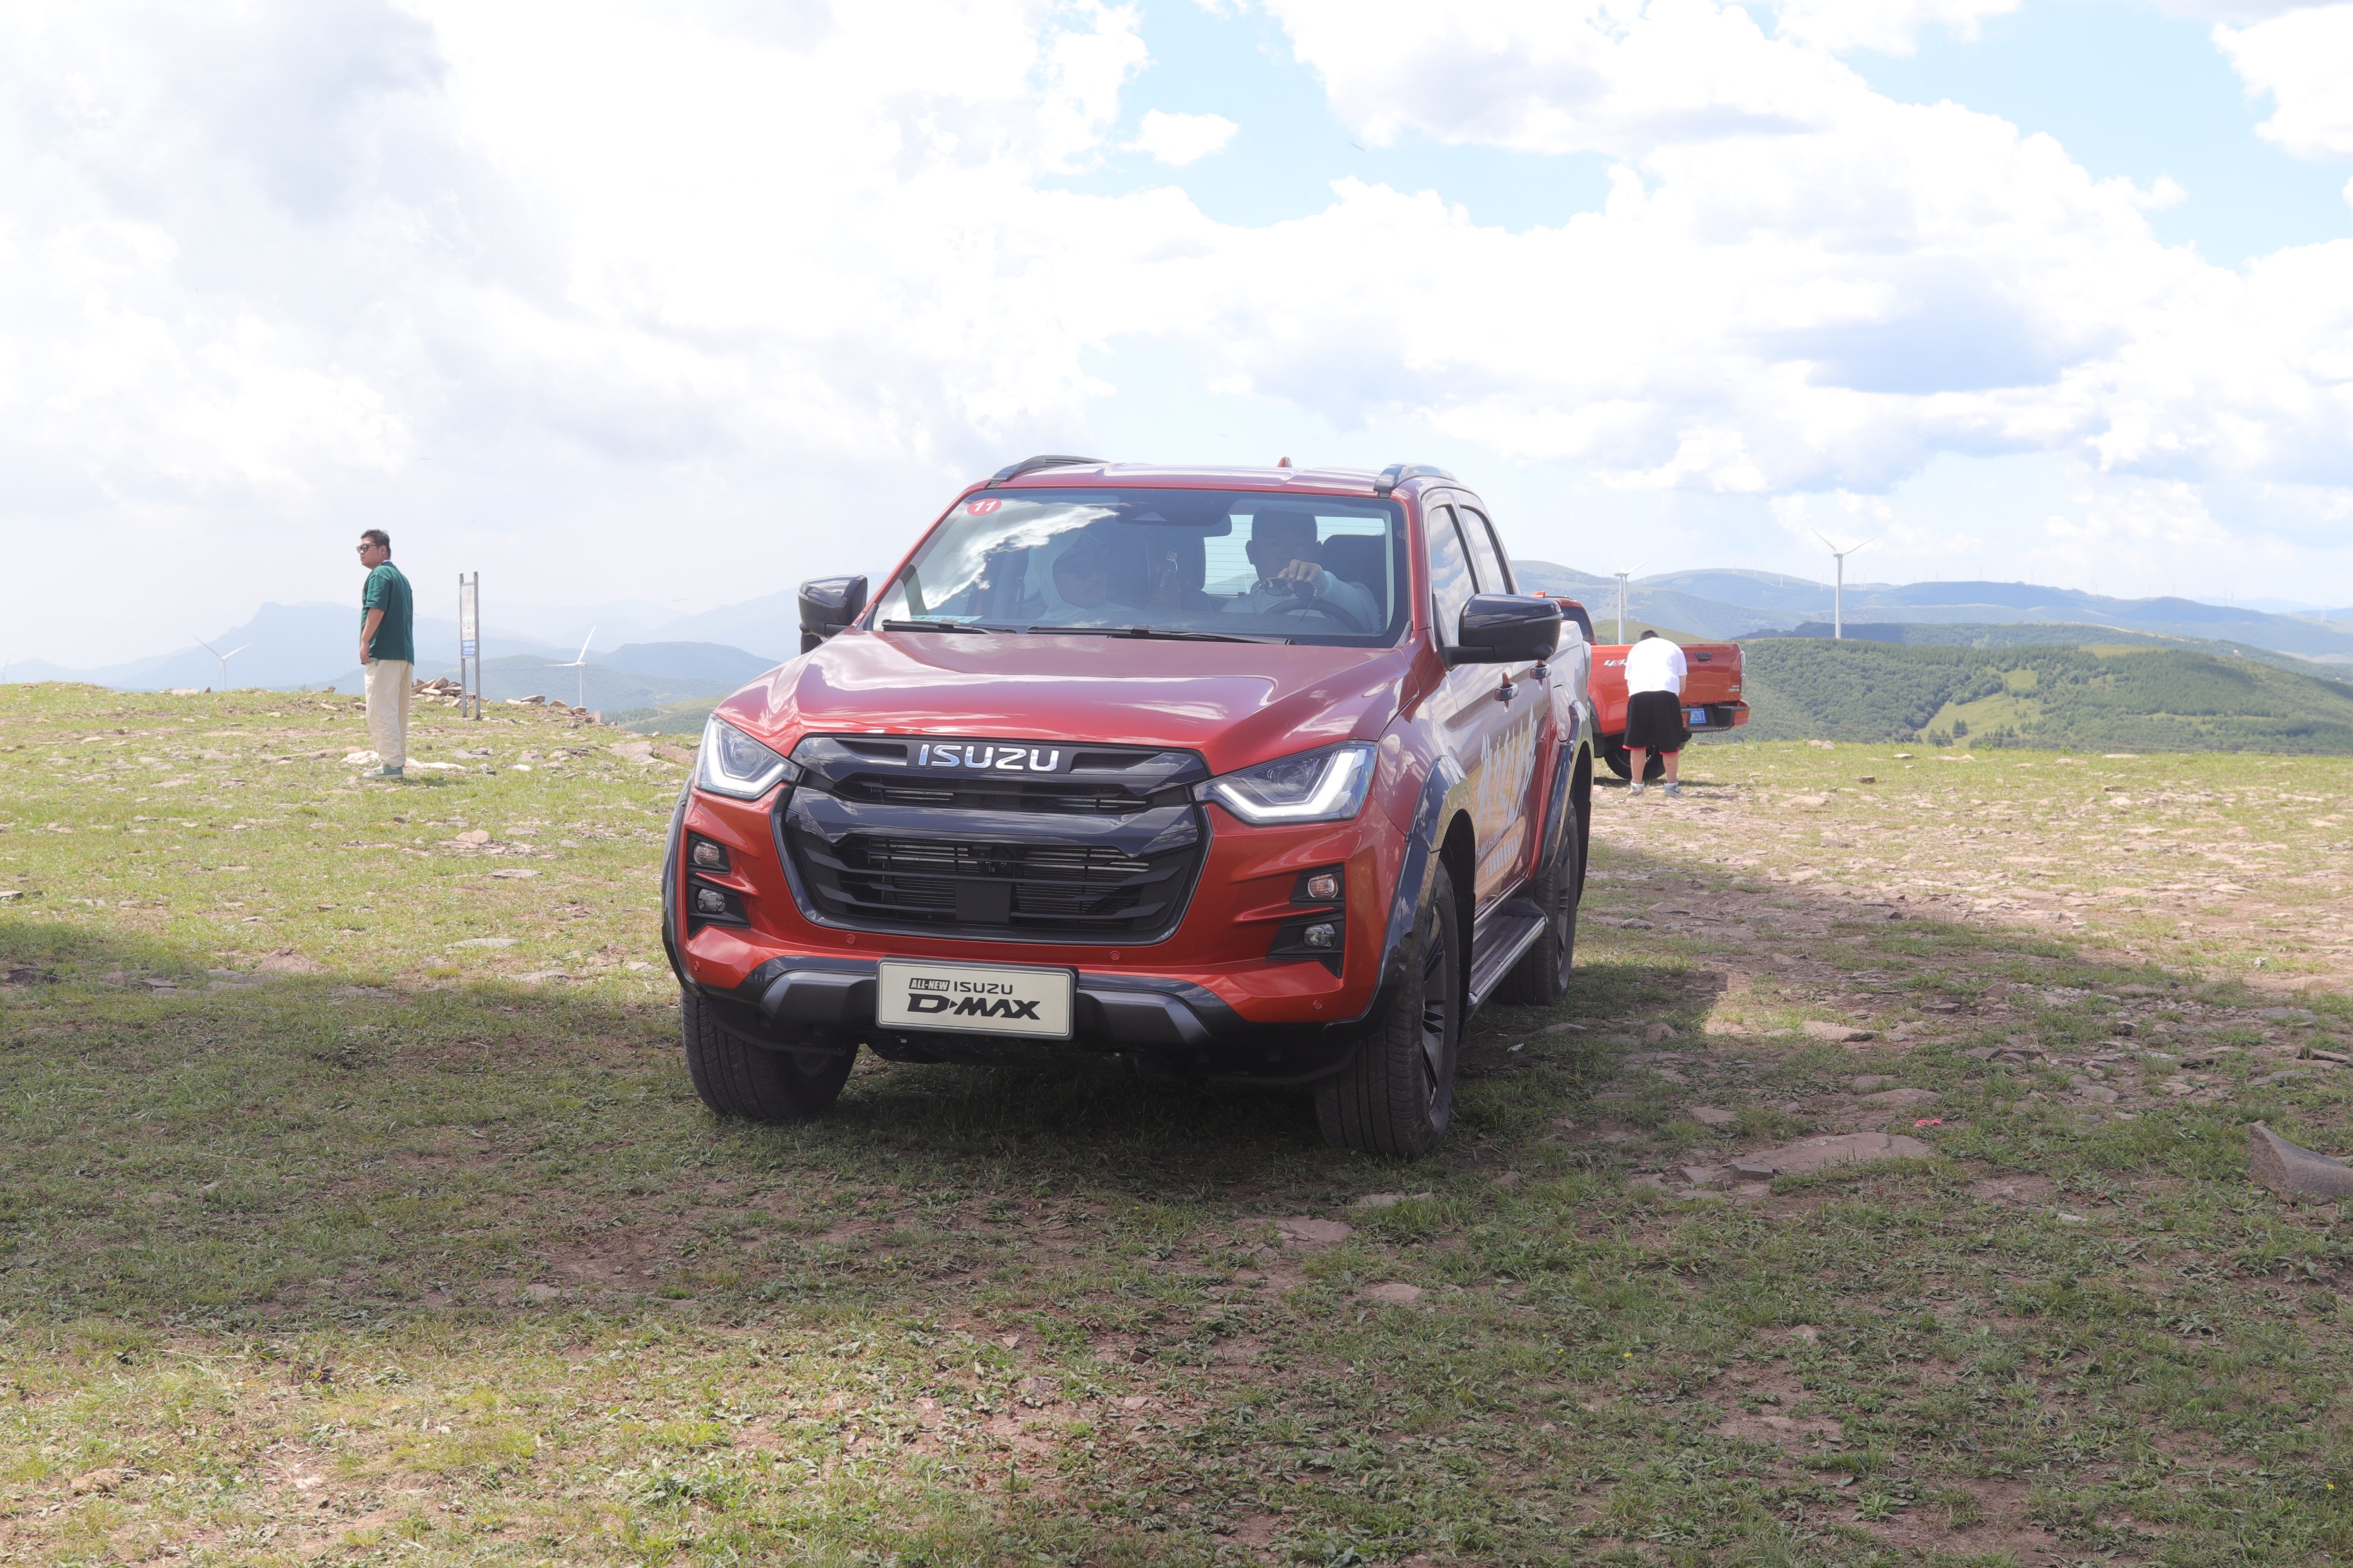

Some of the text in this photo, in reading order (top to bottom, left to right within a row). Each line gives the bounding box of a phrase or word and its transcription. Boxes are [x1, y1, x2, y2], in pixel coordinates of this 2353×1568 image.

[974, 501, 997, 512] 11
[918, 743, 1060, 772] ISUZU
[910, 979, 1013, 995] ALL-NEW ISUZU
[907, 993, 1041, 1020] D-MAX
